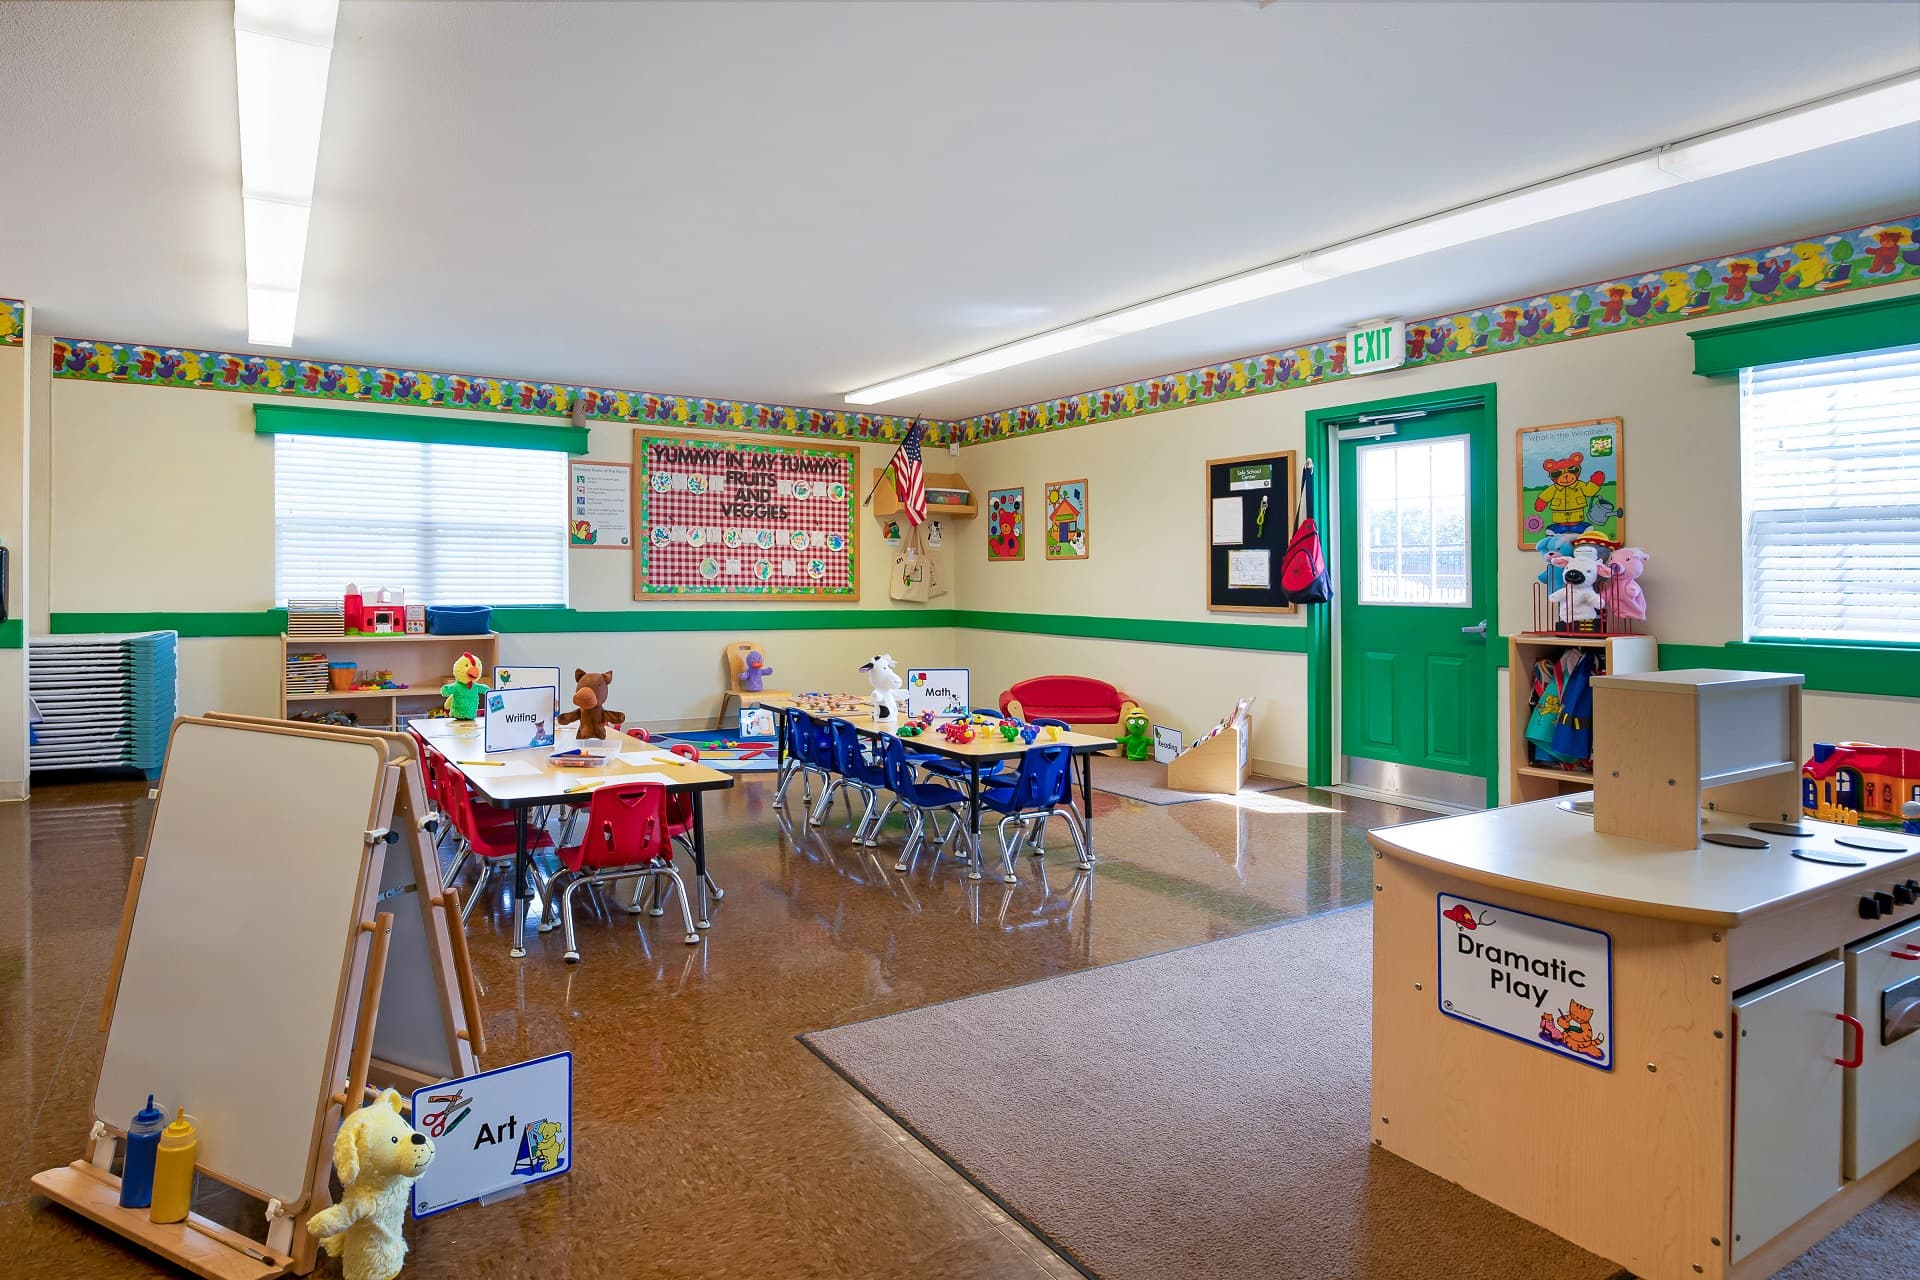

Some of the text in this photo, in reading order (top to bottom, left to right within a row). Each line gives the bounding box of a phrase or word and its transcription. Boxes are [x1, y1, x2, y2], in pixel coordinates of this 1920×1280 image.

[1354, 327, 1392, 365] EXIT
[653, 447, 721, 465] YUMMY
[725, 452, 745, 467] IN
[752, 457, 776, 471] MY
[726, 470, 777, 488] FRUITS
[735, 488, 772, 503] AND
[720, 503, 788, 520] VEGGIES
[925, 688, 951, 697] Math
[505, 713, 537, 723] Writing
[1458, 932, 1587, 988] Dramatic
[1490, 968, 1549, 1008] Play
[473, 1115, 517, 1150] Art
